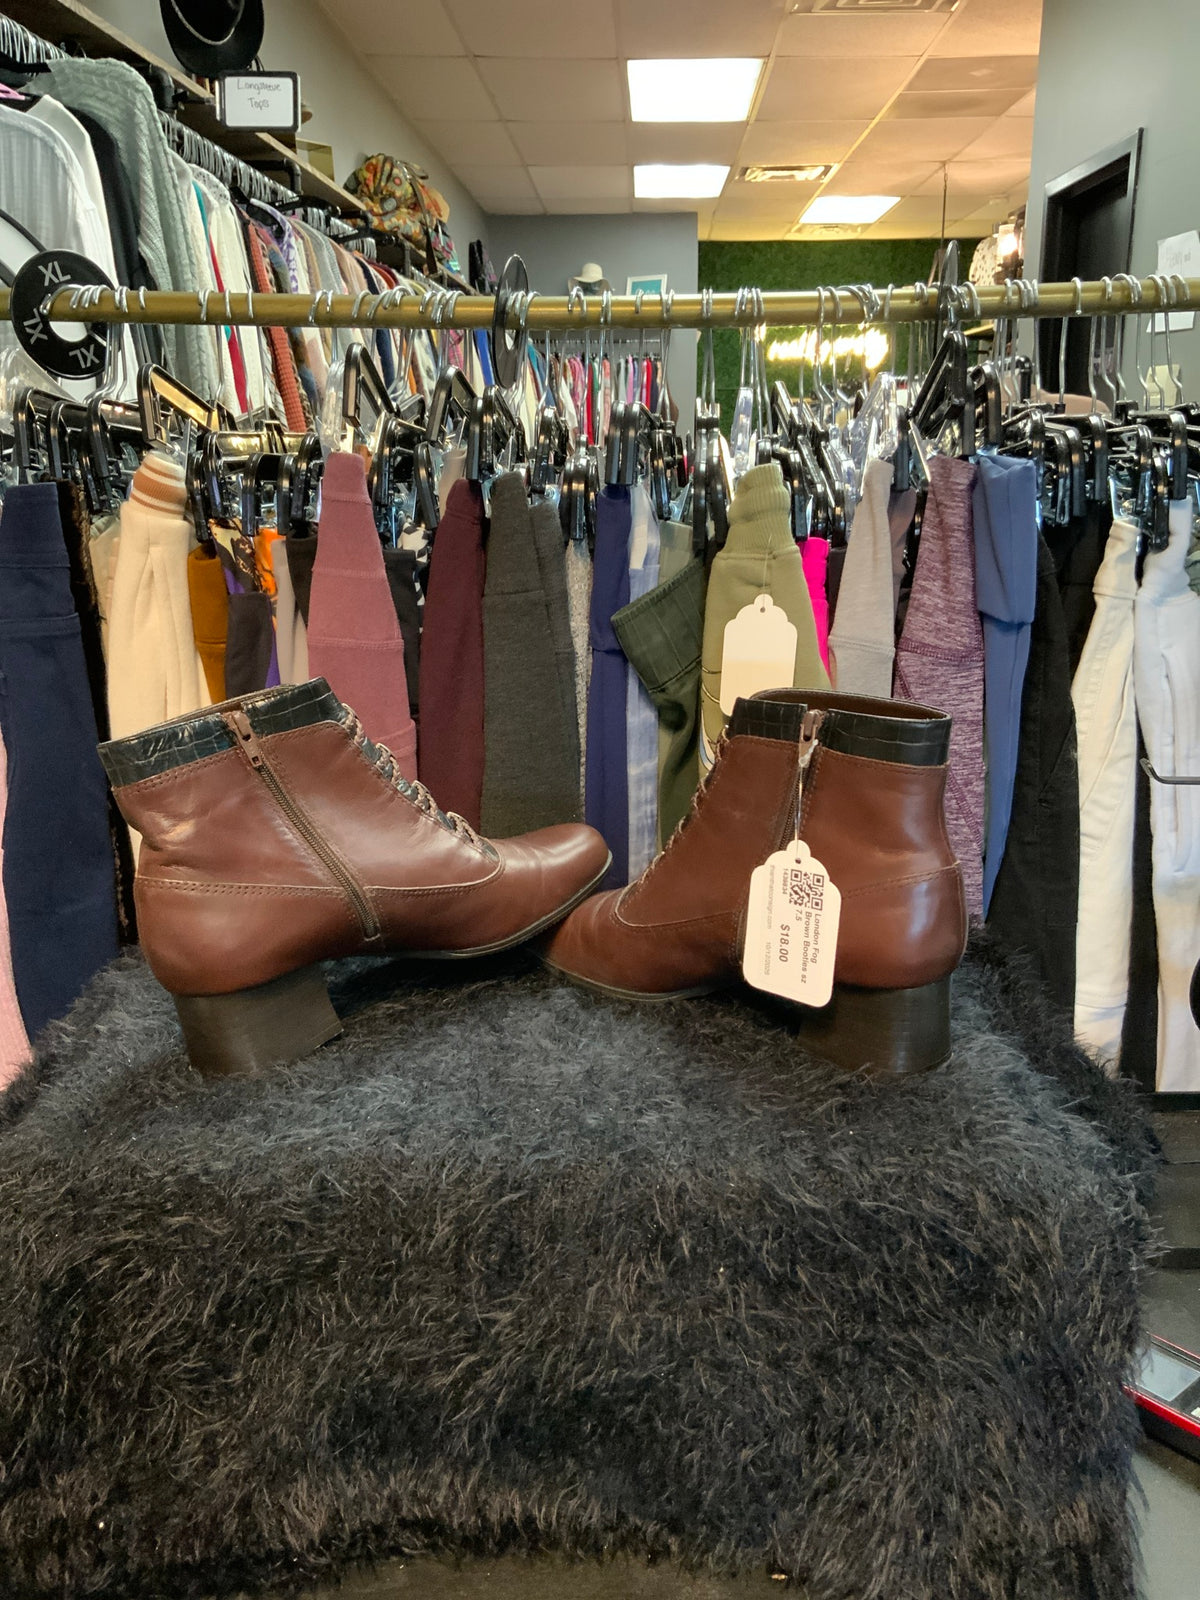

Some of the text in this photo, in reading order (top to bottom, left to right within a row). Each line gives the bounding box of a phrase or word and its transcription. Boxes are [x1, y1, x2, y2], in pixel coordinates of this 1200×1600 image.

[248, 97, 270, 111] Tops
[38, 261, 72, 287] XL
[23, 307, 48, 345] XL
[68, 344, 100, 369] XL
[795, 909, 803, 922] 7.5
[804, 911, 812, 939] Brown
[779, 924, 791, 963] $18.00
[810, 914, 822, 964] London Fog
[801, 941, 810, 972] Booties
